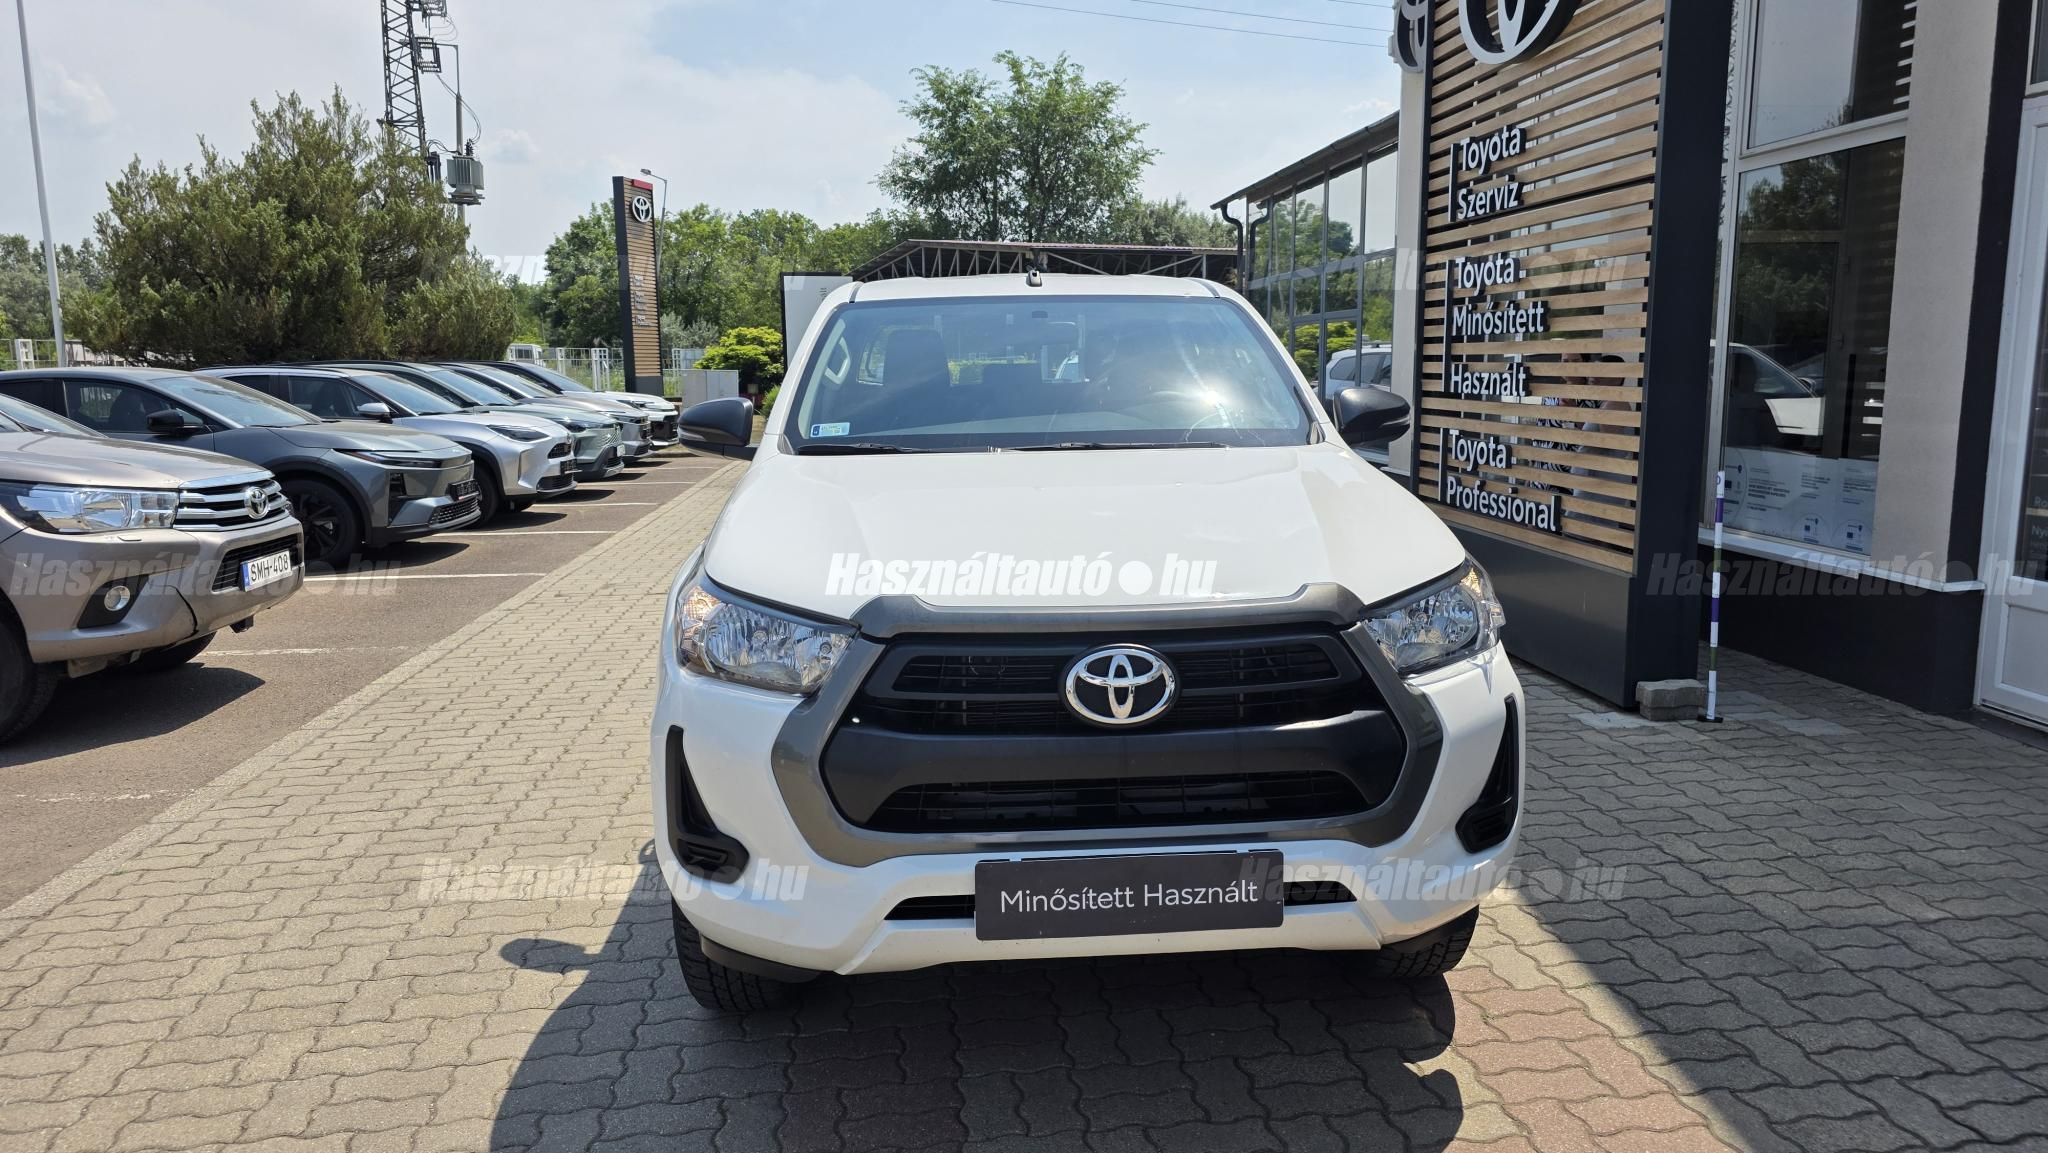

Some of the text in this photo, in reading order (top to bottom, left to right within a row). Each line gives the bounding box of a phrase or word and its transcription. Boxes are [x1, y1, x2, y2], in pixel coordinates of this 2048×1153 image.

[1460, 125, 1521, 175] Toyota
[1457, 174, 1520, 220] Szerviz
[1455, 252, 1515, 296] Toyota
[1452, 300, 1544, 336] Minősített
[1450, 363, 1527, 397] Használt
[1449, 430, 1507, 472] Toyota
[1447, 476, 1556, 532] Professional
[250, 553, 289, 582] SMH-408
[1000, 879, 1258, 913] Minősített Használt
